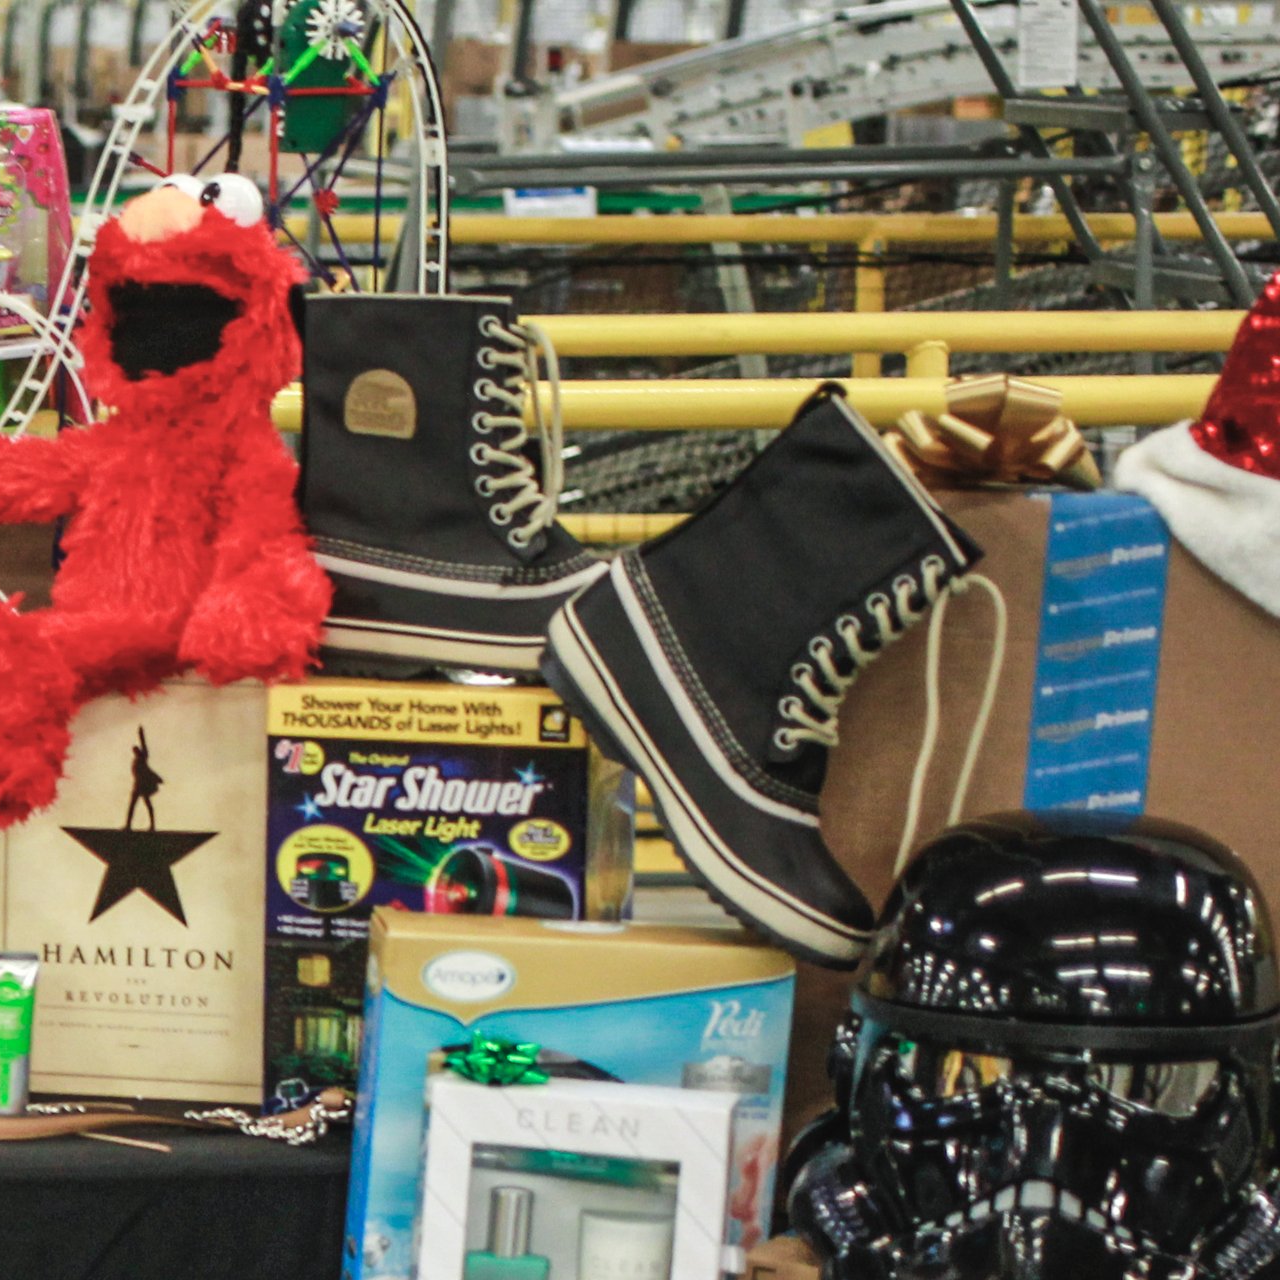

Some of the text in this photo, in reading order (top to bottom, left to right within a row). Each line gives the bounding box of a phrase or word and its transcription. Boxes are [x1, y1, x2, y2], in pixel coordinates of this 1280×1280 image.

[301, 695, 502, 717] Shower Your Home With
[282, 711, 521, 737] THOUSANDS of Laser Lights!
[313, 763, 543, 815] Star Shower
[363, 812, 482, 843] Laser Light
[41, 943, 235, 971] HAMILTON
[65, 989, 209, 1007] REVOLUTION
[701, 1000, 767, 1039] Pedi
[517, 1107, 640, 1138] CLEAN
